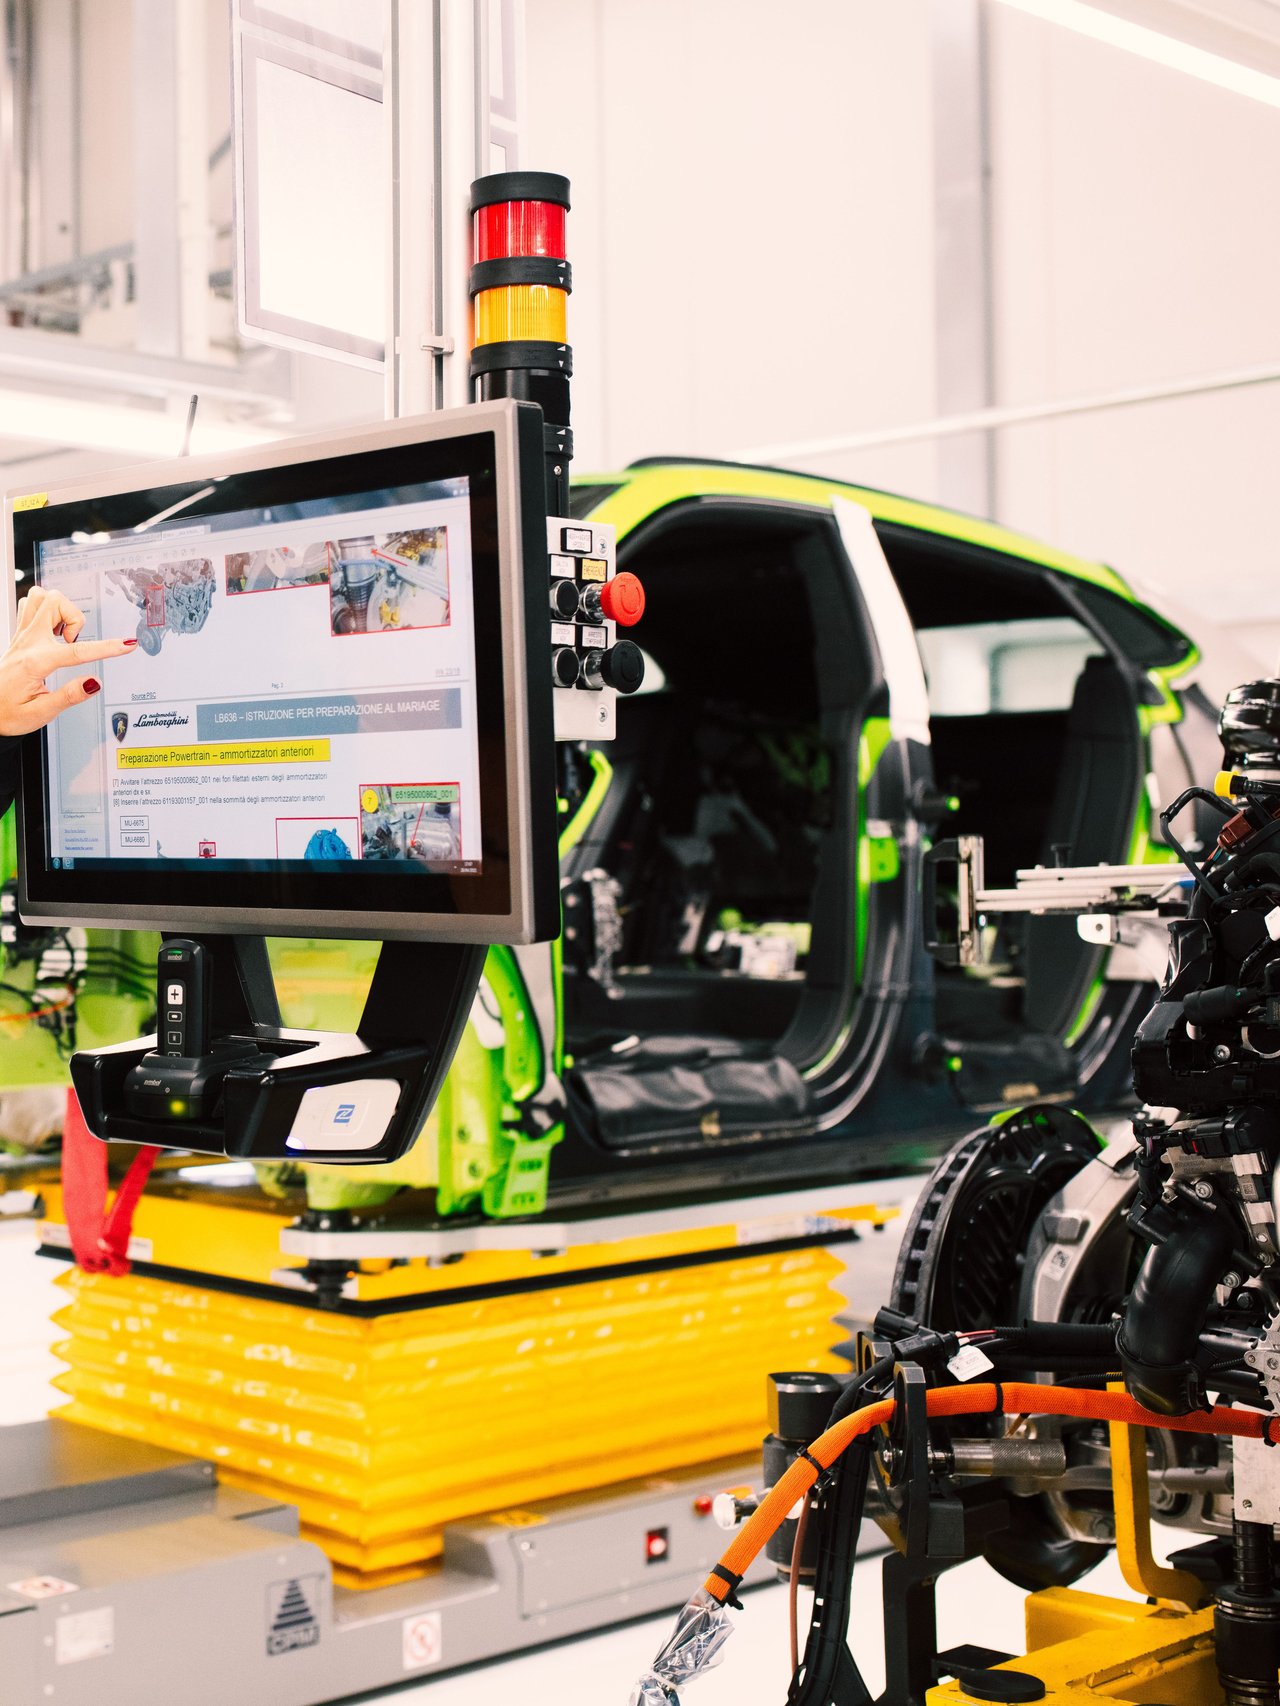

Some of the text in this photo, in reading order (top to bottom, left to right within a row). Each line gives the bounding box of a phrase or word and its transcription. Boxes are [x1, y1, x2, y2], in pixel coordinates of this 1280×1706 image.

[148, 711, 178, 719] automobili
[214, 713, 238, 723] LB636
[245, 709, 295, 722] ISTRUZIONE
[297, 707, 314, 719] PER
[315, 703, 383, 718] PREPARAZIONE
[384, 702, 396, 713] AL
[397, 699, 440, 713] MARIAGE
[133, 713, 189, 728] Lamborghini
[120, 752, 168, 765] Preparazione
[170, 750, 210, 762] Powertrain
[219, 747, 278, 760] ammortizzatori
[280, 744, 314, 757] anteriori
[120, 778, 139, 786] Avvitare
[164, 776, 211, 786] 65195000862_001
[271, 774, 284, 782] degli
[286, 772, 328, 781] ammortizzatori
[209, 796, 222, 804] nella
[223, 795, 246, 804] sommità
[246, 795, 260, 805] degli
[260, 794, 301, 803] ammortizzatori
[302, 794, 325, 802] anteriori
[395, 790, 453, 800] 65195000862_001
